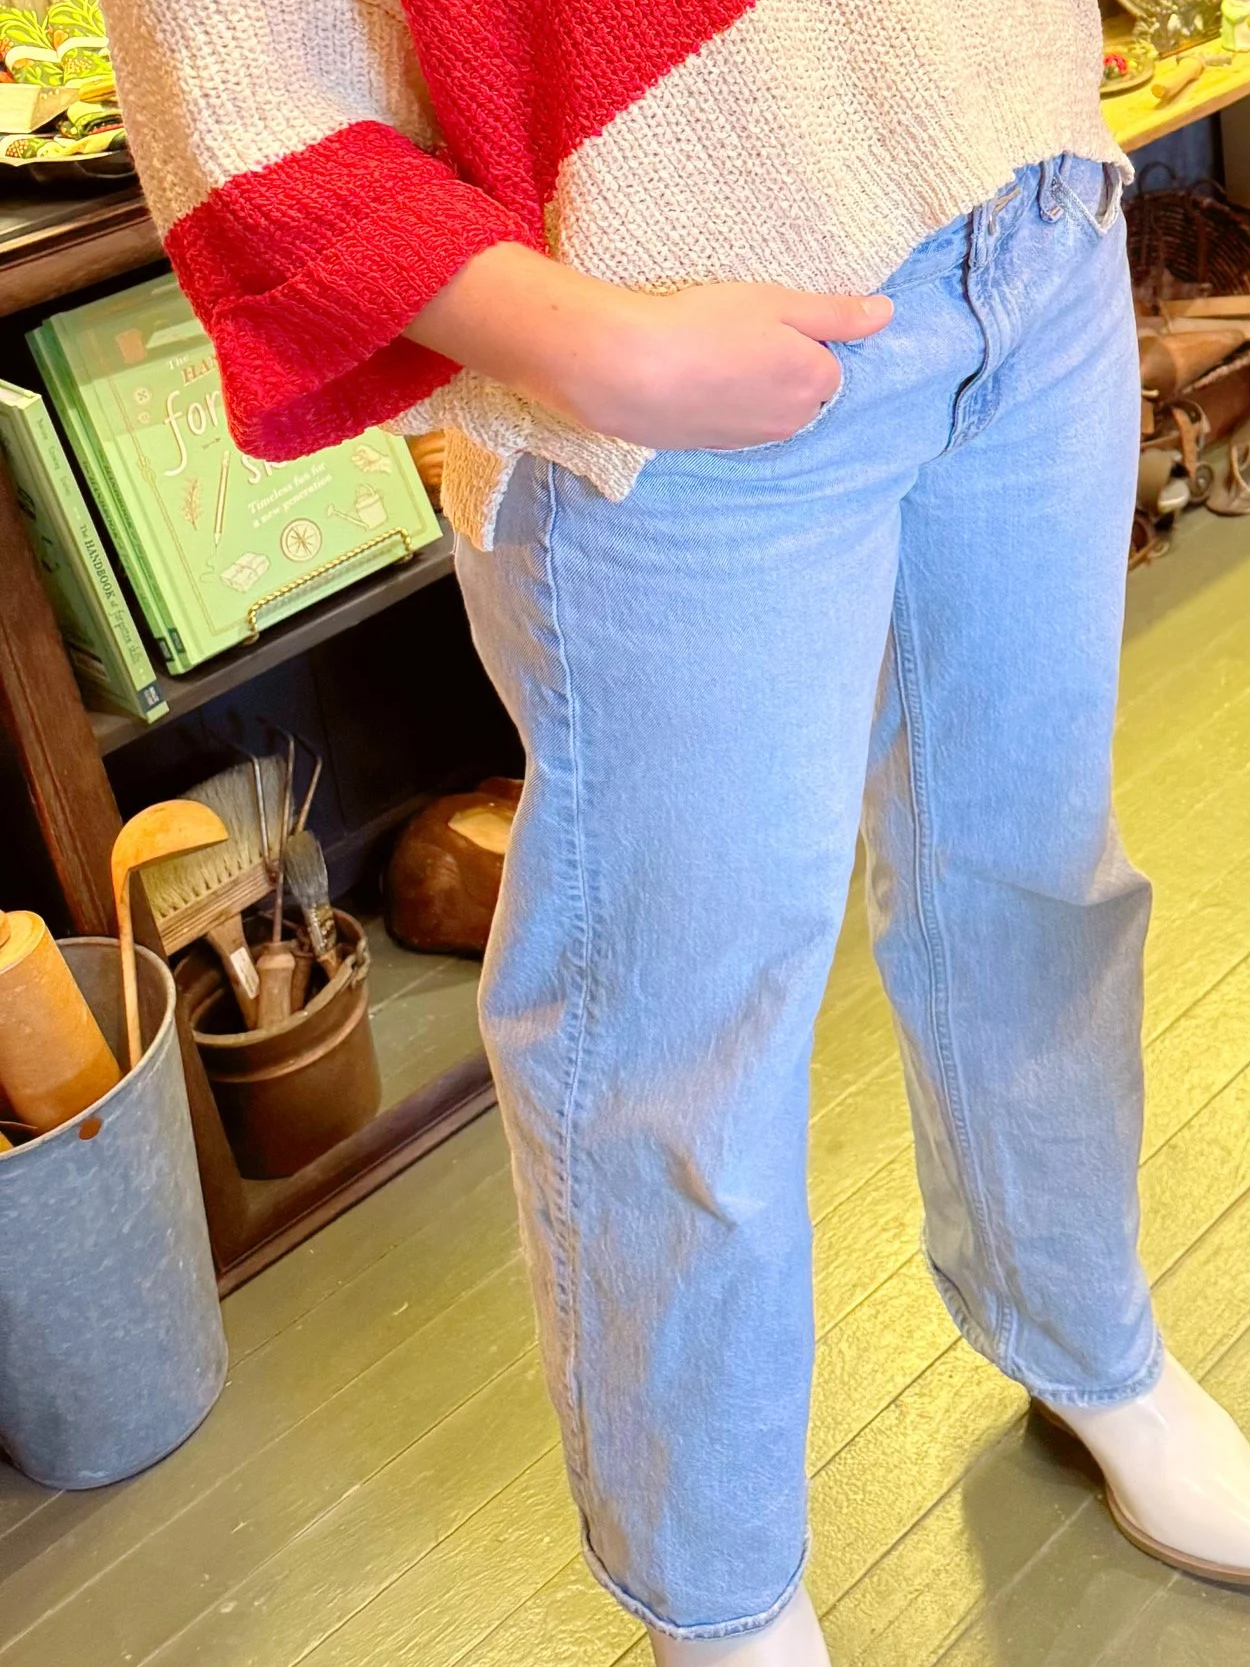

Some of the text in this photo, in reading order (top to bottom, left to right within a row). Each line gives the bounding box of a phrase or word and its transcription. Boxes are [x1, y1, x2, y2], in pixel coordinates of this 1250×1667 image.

[167, 354, 190, 371] The
[248, 483, 293, 515] Timeless
[262, 508, 281, 524] new
[282, 474, 333, 515] generation
[80, 524, 91, 540] The
[84, 539, 116, 601] HANDBOOK
